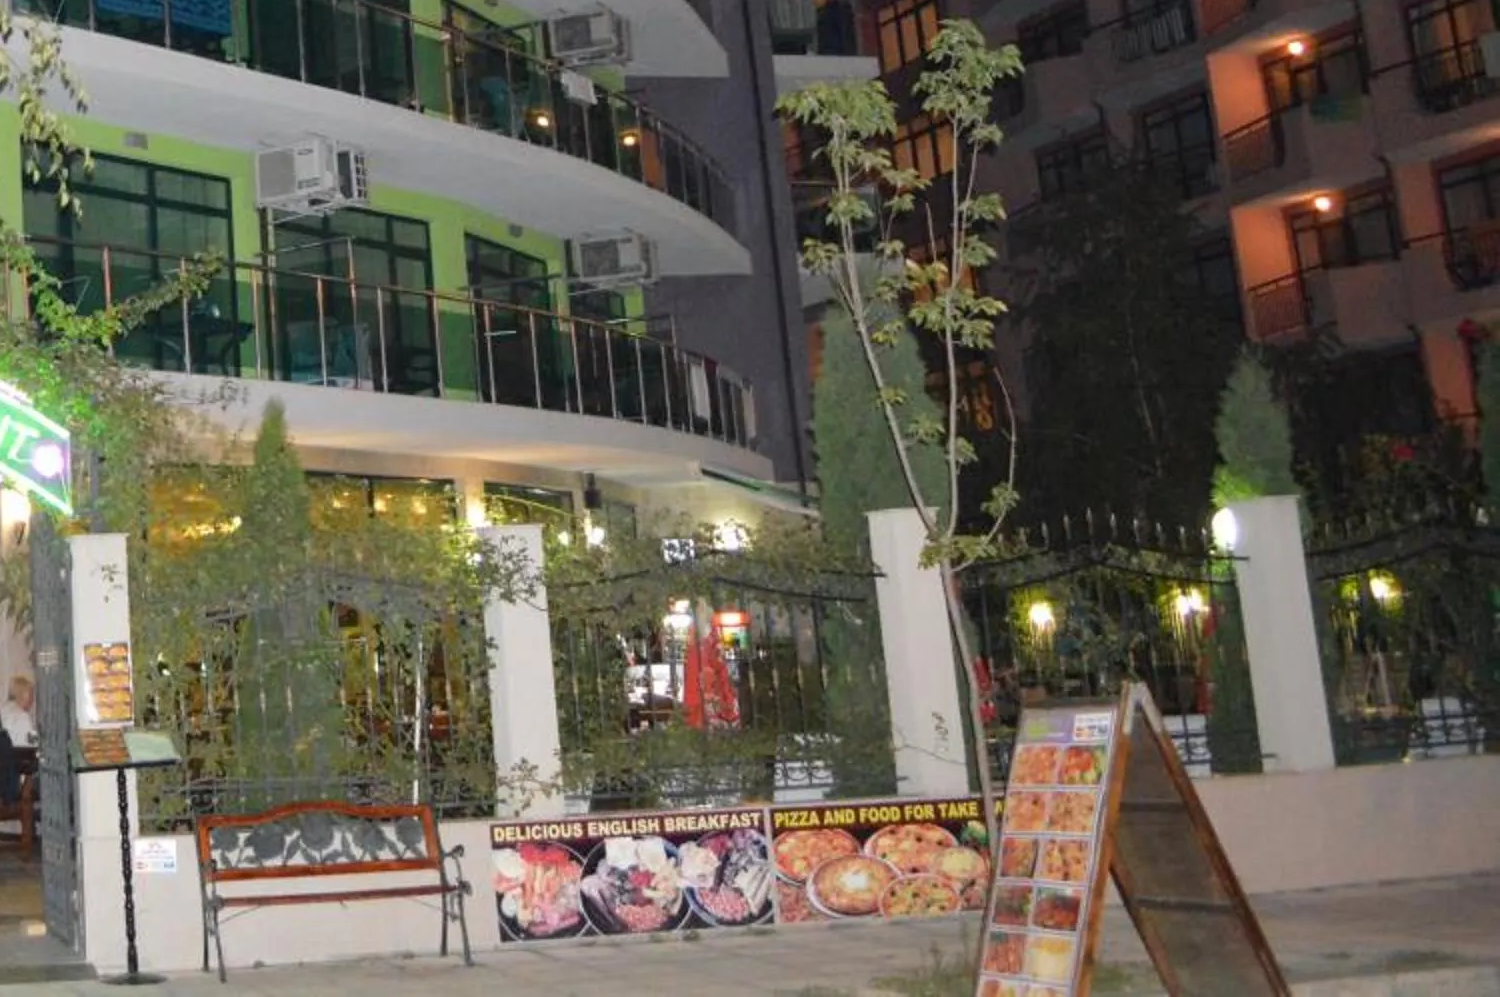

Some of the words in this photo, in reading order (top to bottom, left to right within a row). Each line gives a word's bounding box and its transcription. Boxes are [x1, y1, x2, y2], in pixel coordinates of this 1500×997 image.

[494, 823, 583, 842] DELICIOUS
[588, 817, 661, 836] ENGLISH
[664, 811, 762, 831] BREAKFAST
[774, 810, 820, 827] PIZZA
[823, 809, 854, 824] AND
[859, 806, 901, 822] FOOD
[904, 804, 935, 820] FOR
[940, 801, 979, 818] TAKE
